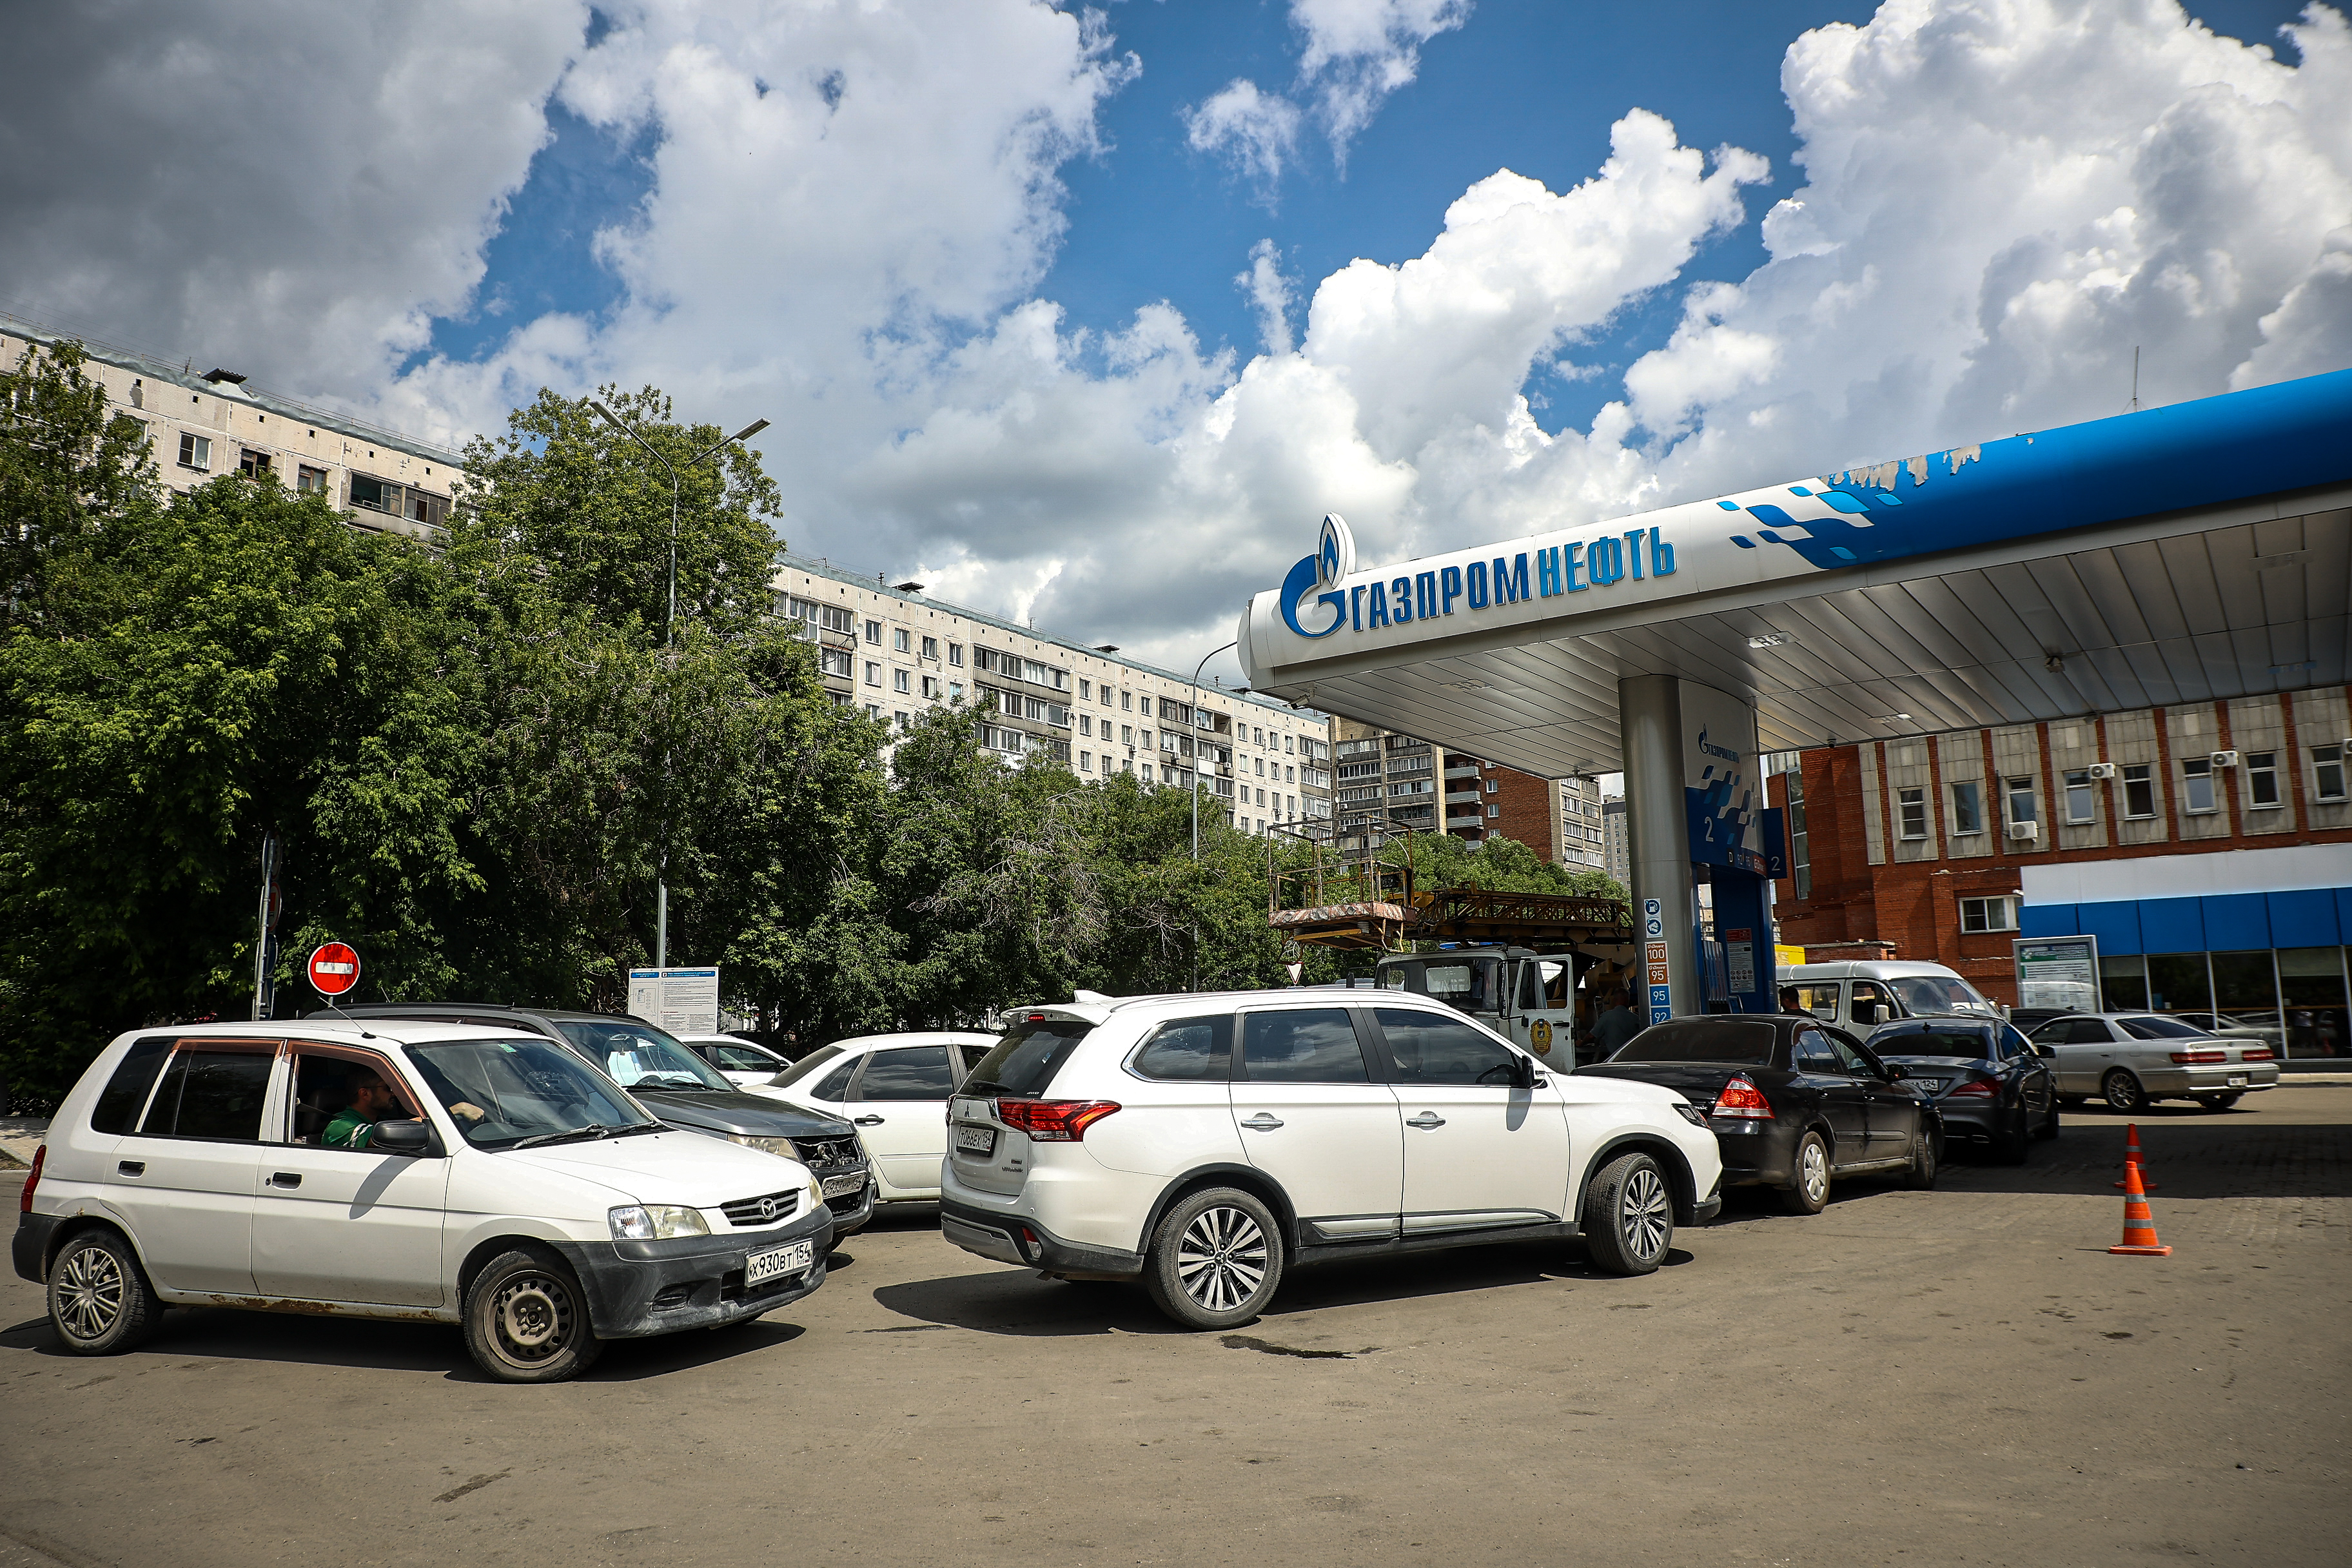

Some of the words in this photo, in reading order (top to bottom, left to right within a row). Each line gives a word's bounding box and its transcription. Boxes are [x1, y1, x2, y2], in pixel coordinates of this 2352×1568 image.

[1351, 525, 1678, 632] ГАЗПРОМНЕФТЬ
[1704, 816, 1714, 842] 2
[1729, 852, 1733, 863] D
[1770, 856, 1781, 871] 2
[1648, 949, 1665, 959] 100
[1651, 970, 1664, 981] 95
[1653, 990, 1665, 1001] 95
[959, 1130, 981, 1148] Т066ЕХ
[982, 1131, 992, 1144] 154
[752, 1252, 792, 1279] Х930ВТ
[794, 1243, 808, 1260] 154
